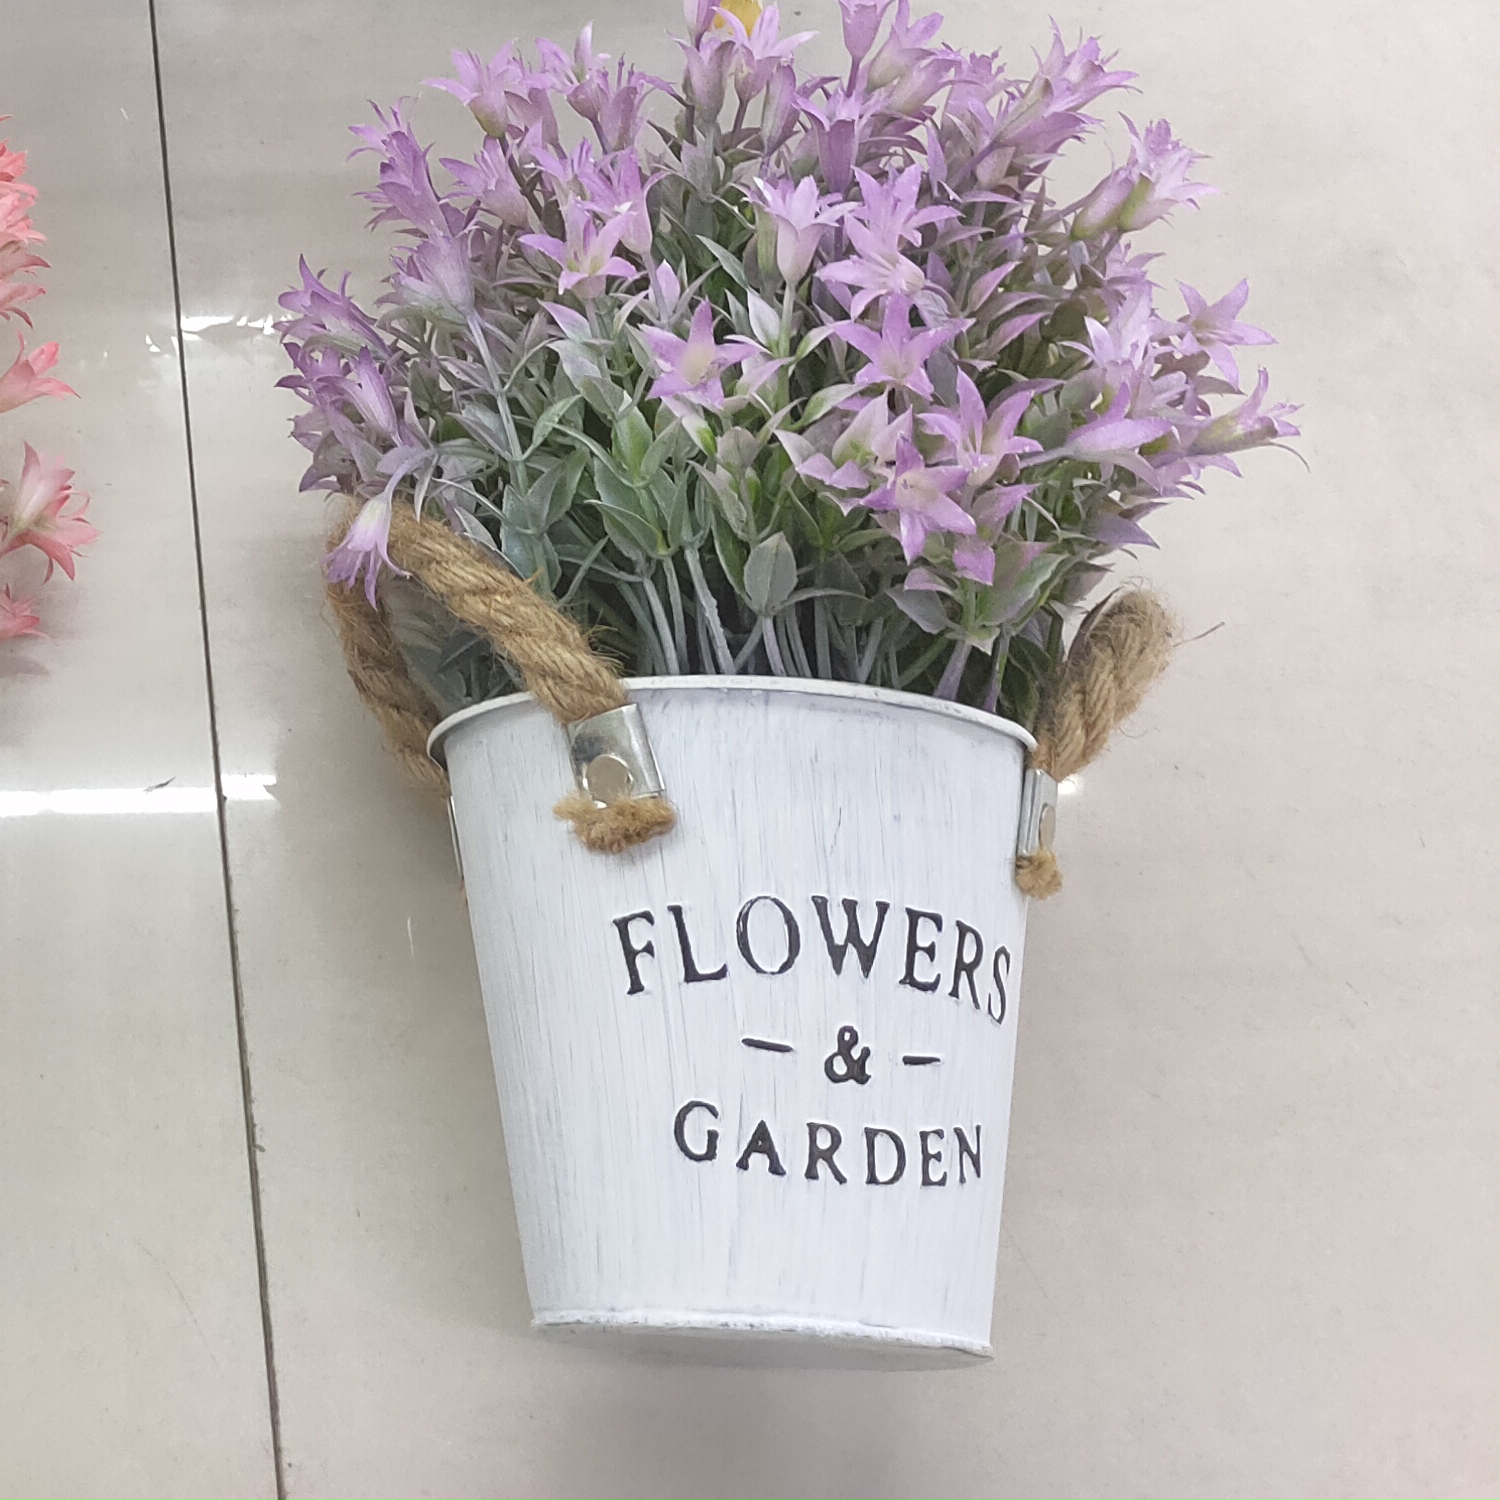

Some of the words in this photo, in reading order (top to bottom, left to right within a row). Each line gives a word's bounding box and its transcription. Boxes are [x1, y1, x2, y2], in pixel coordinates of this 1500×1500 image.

[611, 895, 1011, 1025] FLOWERS
[823, 1025, 872, 1085] &
[673, 1100, 982, 1186] GARDEN
